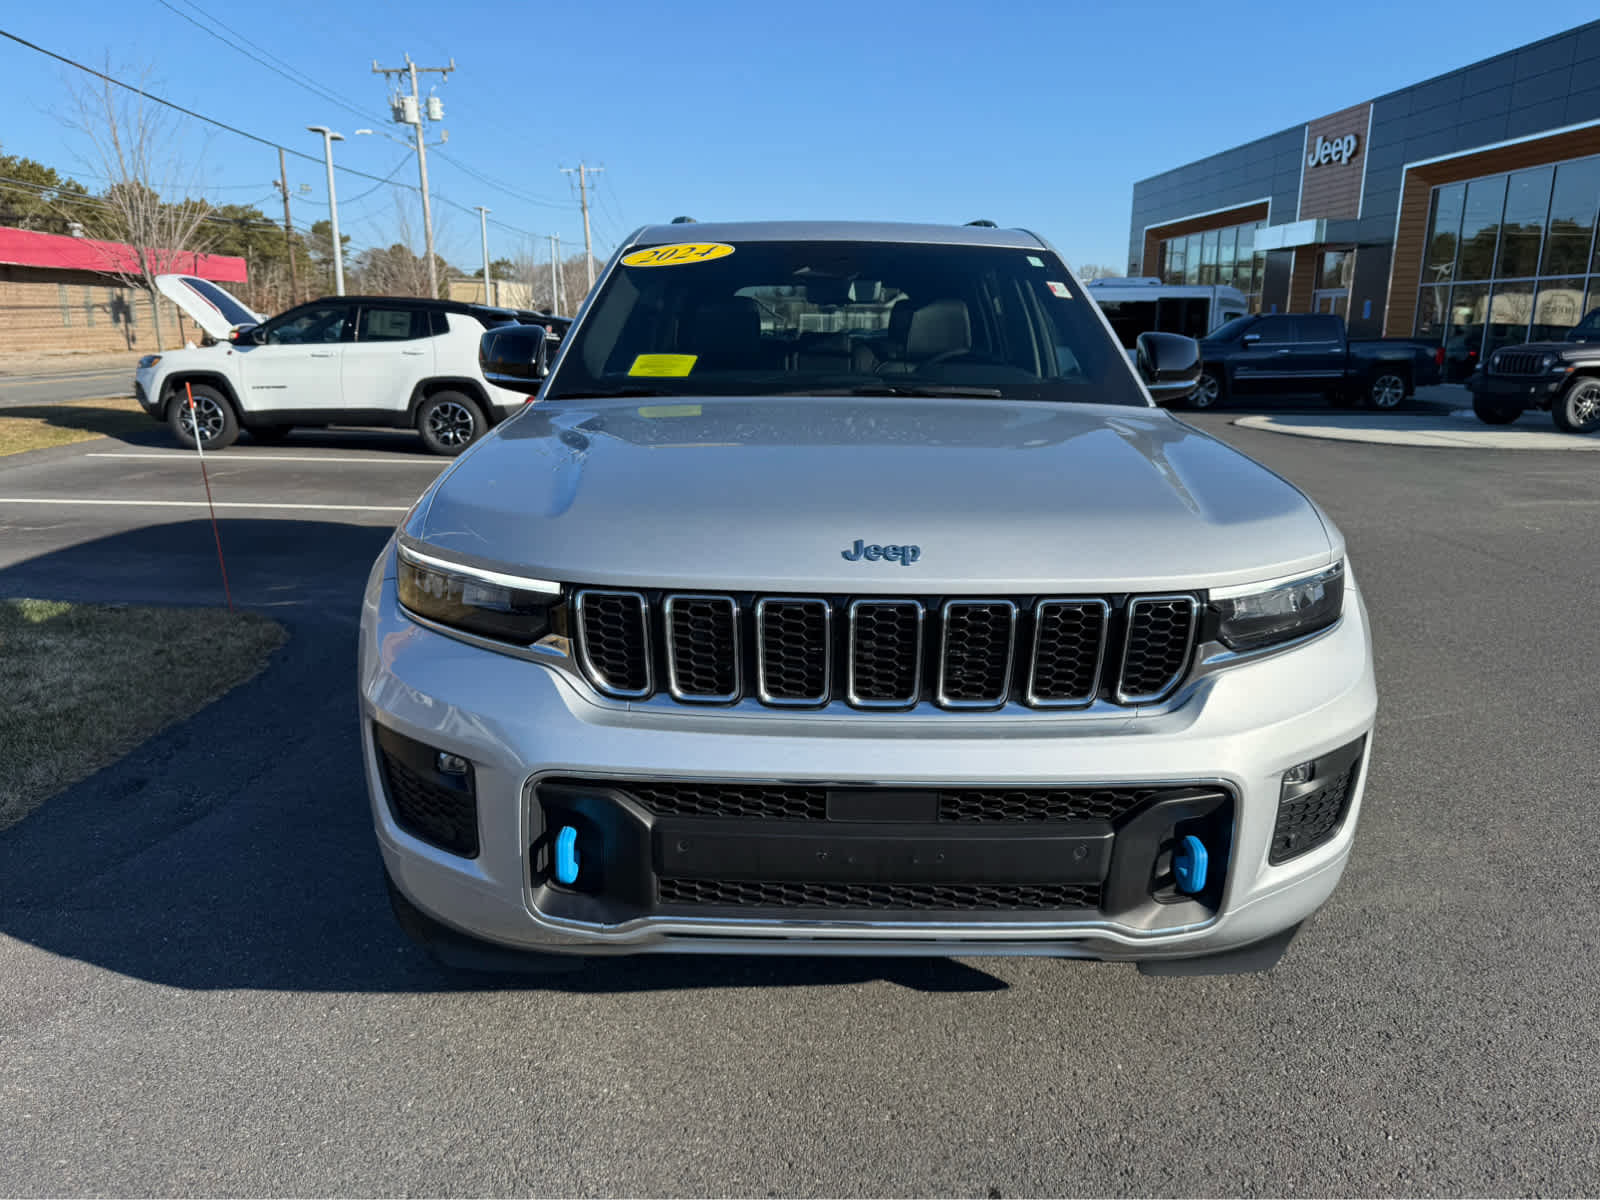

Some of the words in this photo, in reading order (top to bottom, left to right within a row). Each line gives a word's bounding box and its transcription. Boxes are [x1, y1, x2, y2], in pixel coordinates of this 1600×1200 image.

[1308, 133, 1357, 167] Jeep
[637, 245, 719, 264] 2024
[841, 539, 921, 567] Jeep
